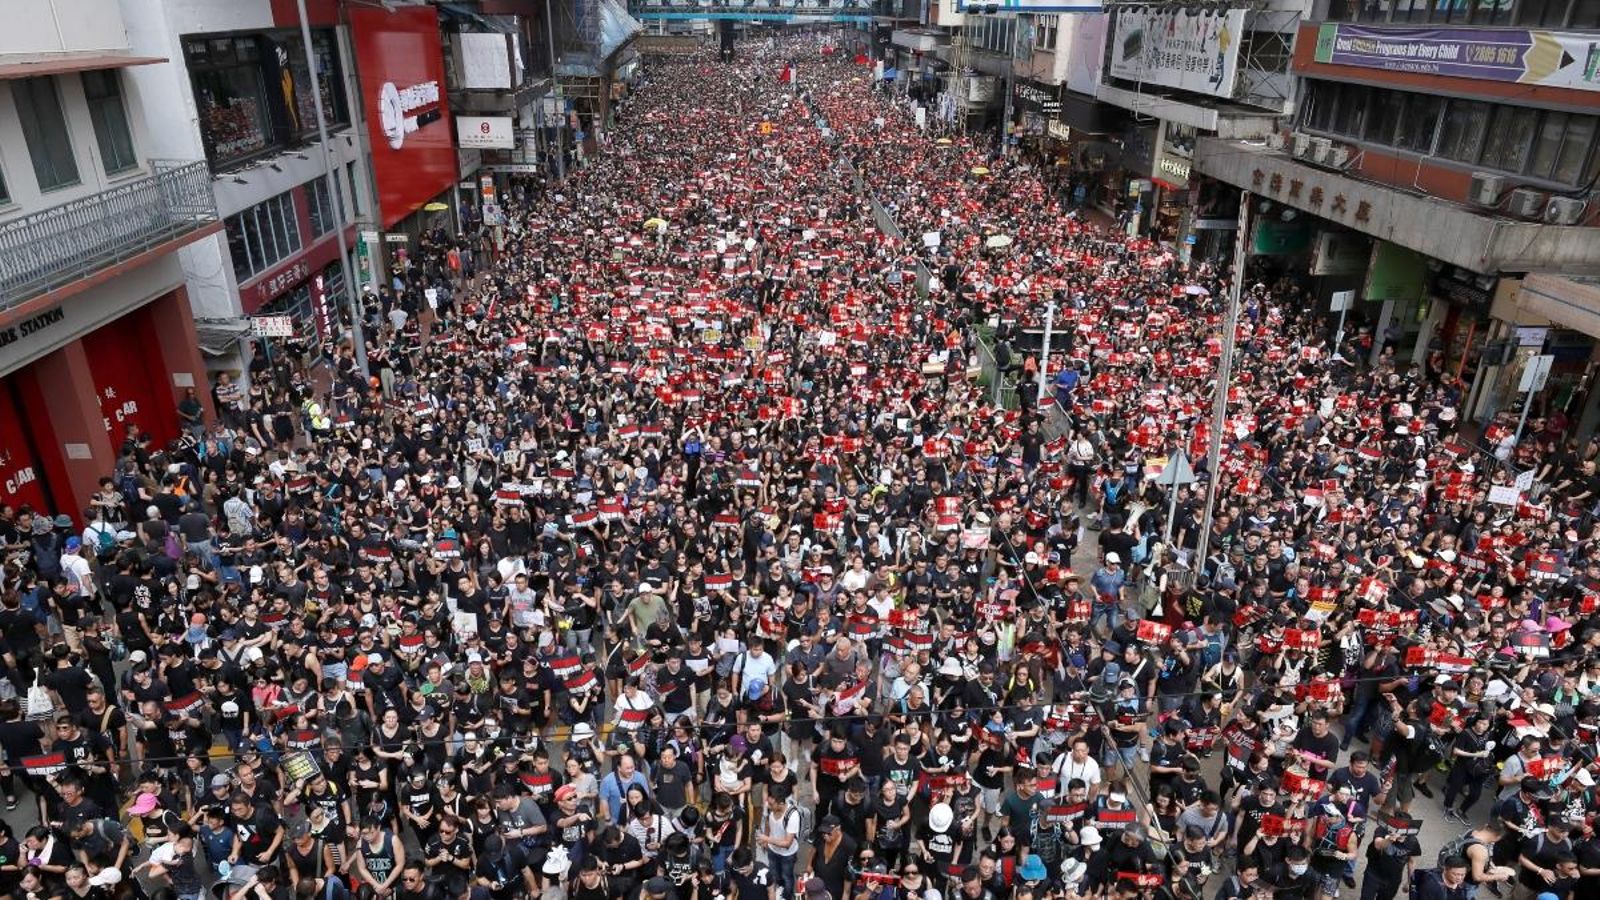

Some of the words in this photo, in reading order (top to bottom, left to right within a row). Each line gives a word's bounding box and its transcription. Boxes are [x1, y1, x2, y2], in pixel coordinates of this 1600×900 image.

[1407, 42, 1418, 56] for
[1418, 43, 1438, 59] Every
[1438, 44, 1460, 59] Child
[19, 306, 65, 338] STATION
